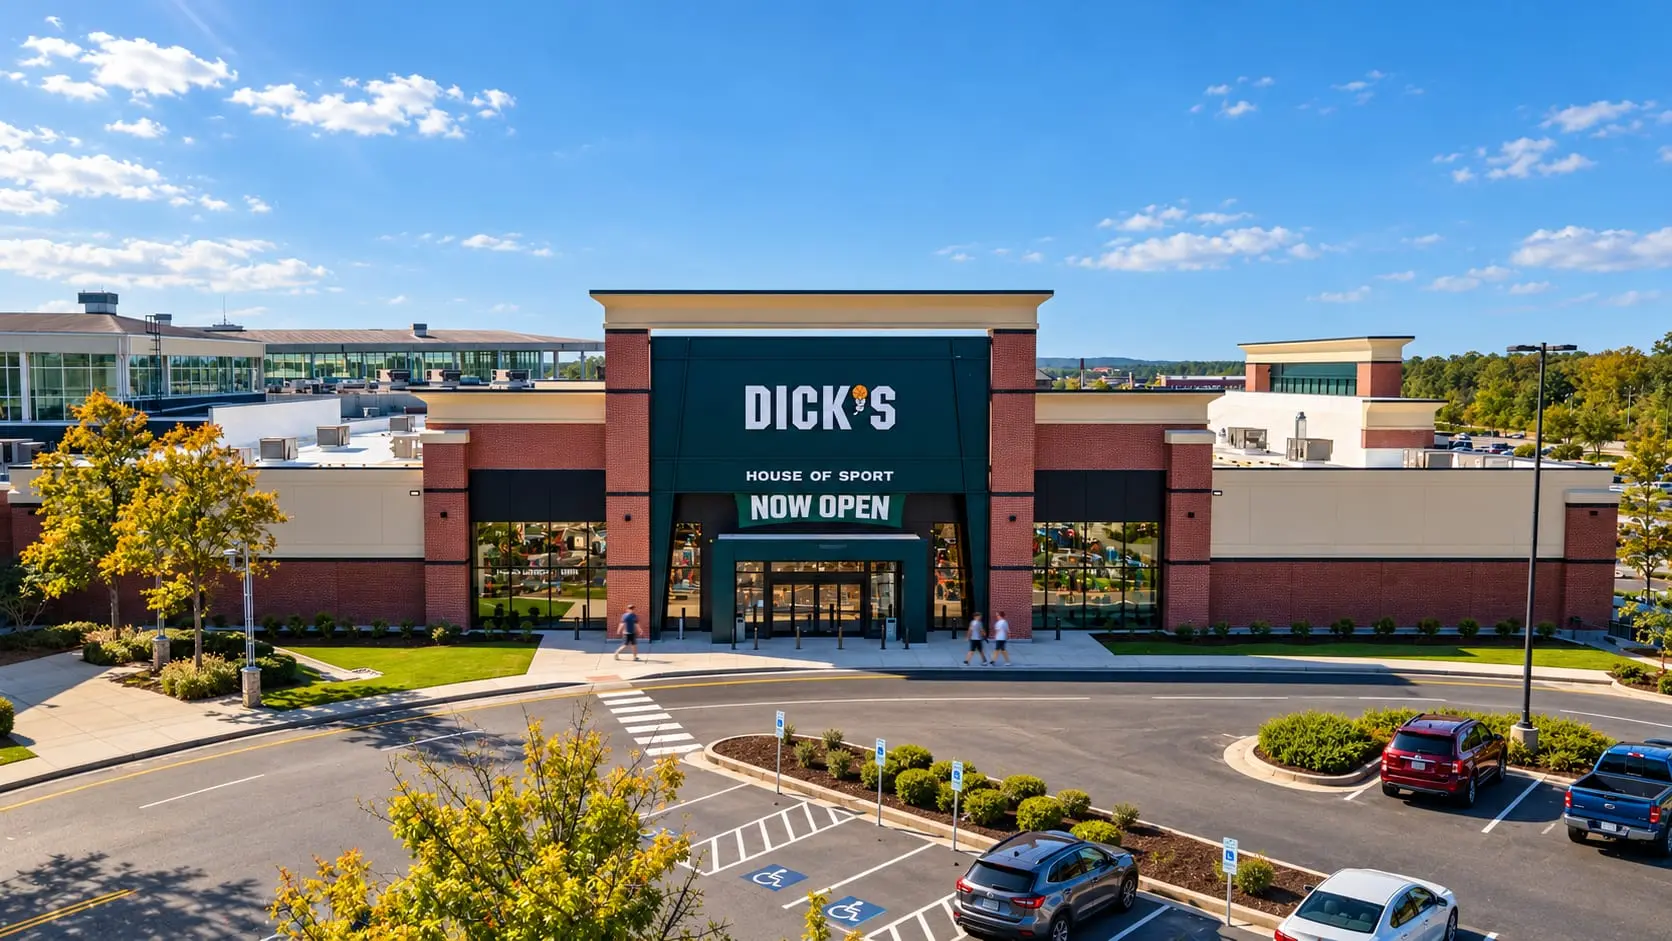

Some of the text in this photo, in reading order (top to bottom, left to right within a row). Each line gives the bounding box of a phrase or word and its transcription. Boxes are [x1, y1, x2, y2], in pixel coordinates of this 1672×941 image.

[745, 384, 896, 430] DICK'S
[746, 471, 894, 482] HOUSE OF SPORT
[750, 494, 890, 521] NOW OPEN
